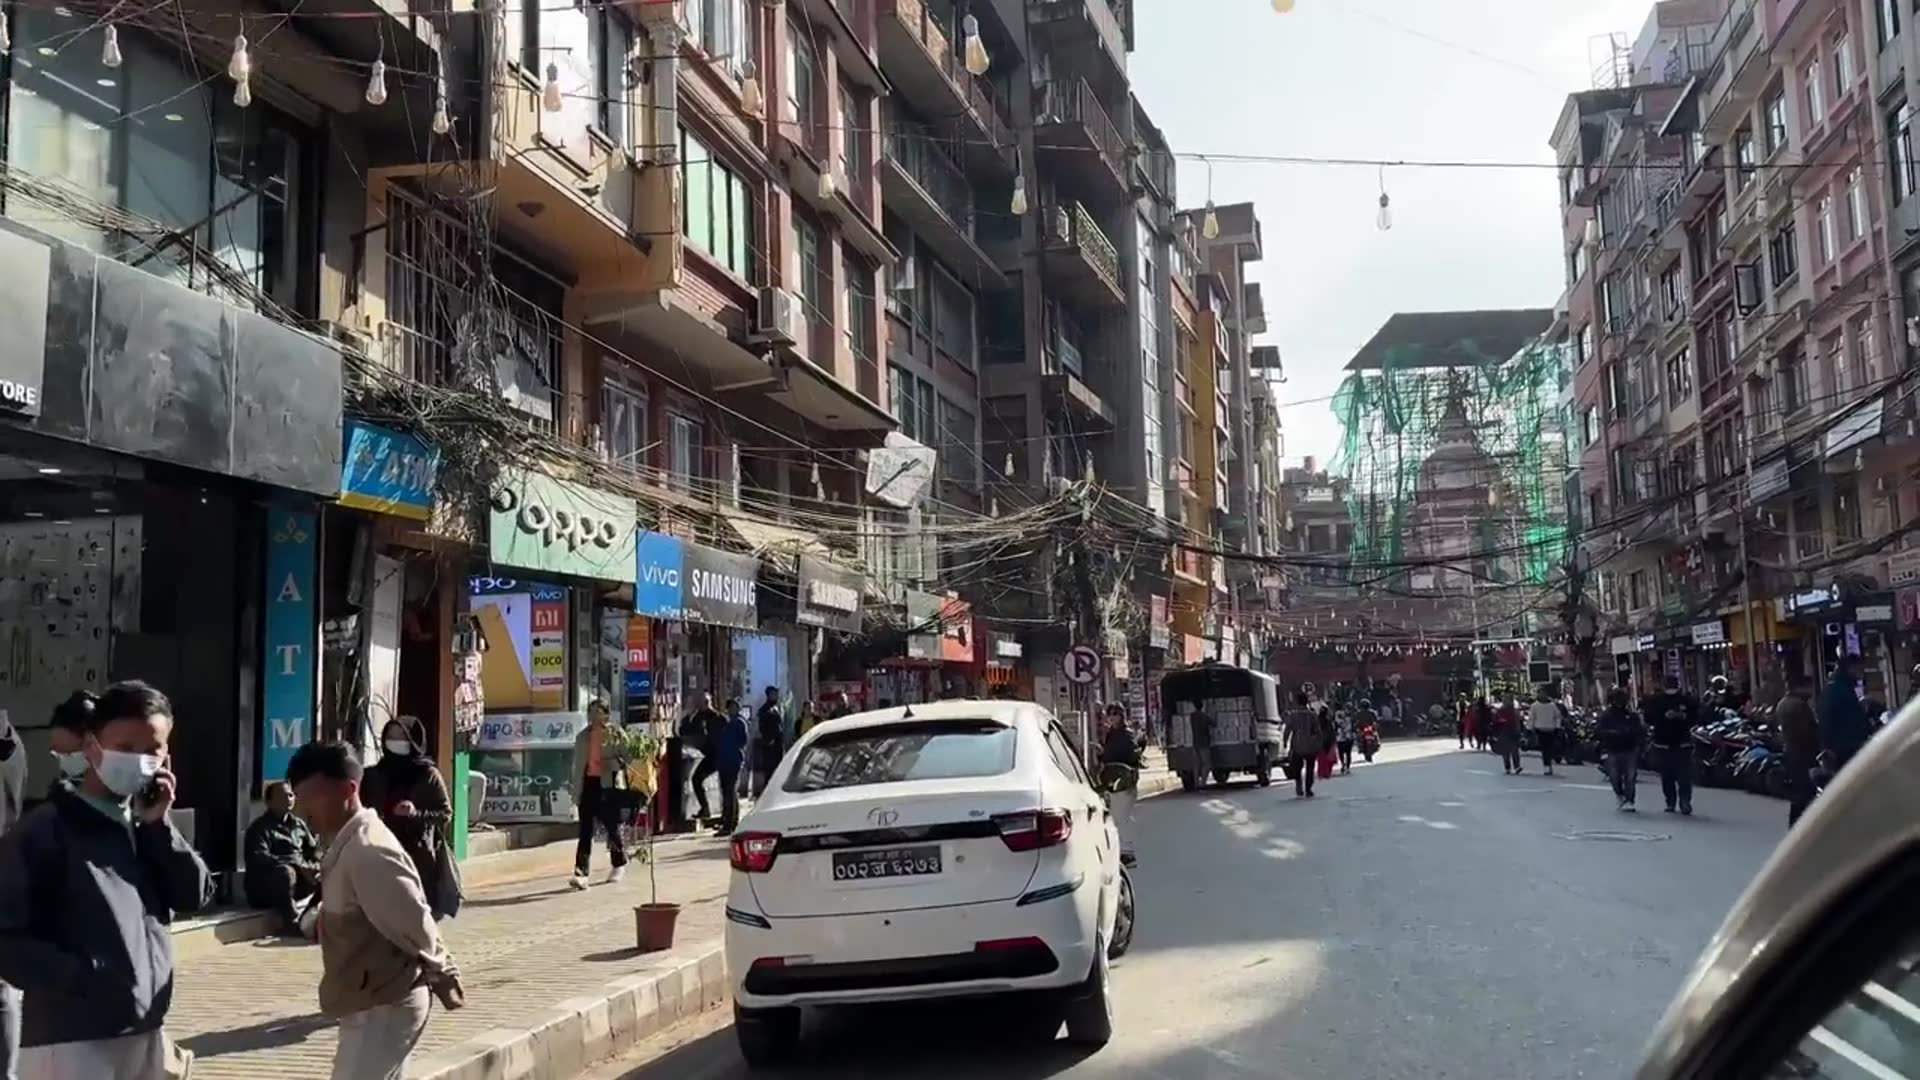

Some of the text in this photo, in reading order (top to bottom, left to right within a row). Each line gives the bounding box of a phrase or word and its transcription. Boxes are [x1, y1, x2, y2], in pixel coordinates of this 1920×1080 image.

[0, 379, 36, 405] ORE
[641, 560, 679, 587] vivo
[691, 568, 756, 606] SAMSUNG
[269, 571, 305, 749] ATM
[534, 656, 562, 667] POCO
[512, 800, 537, 812] A78
